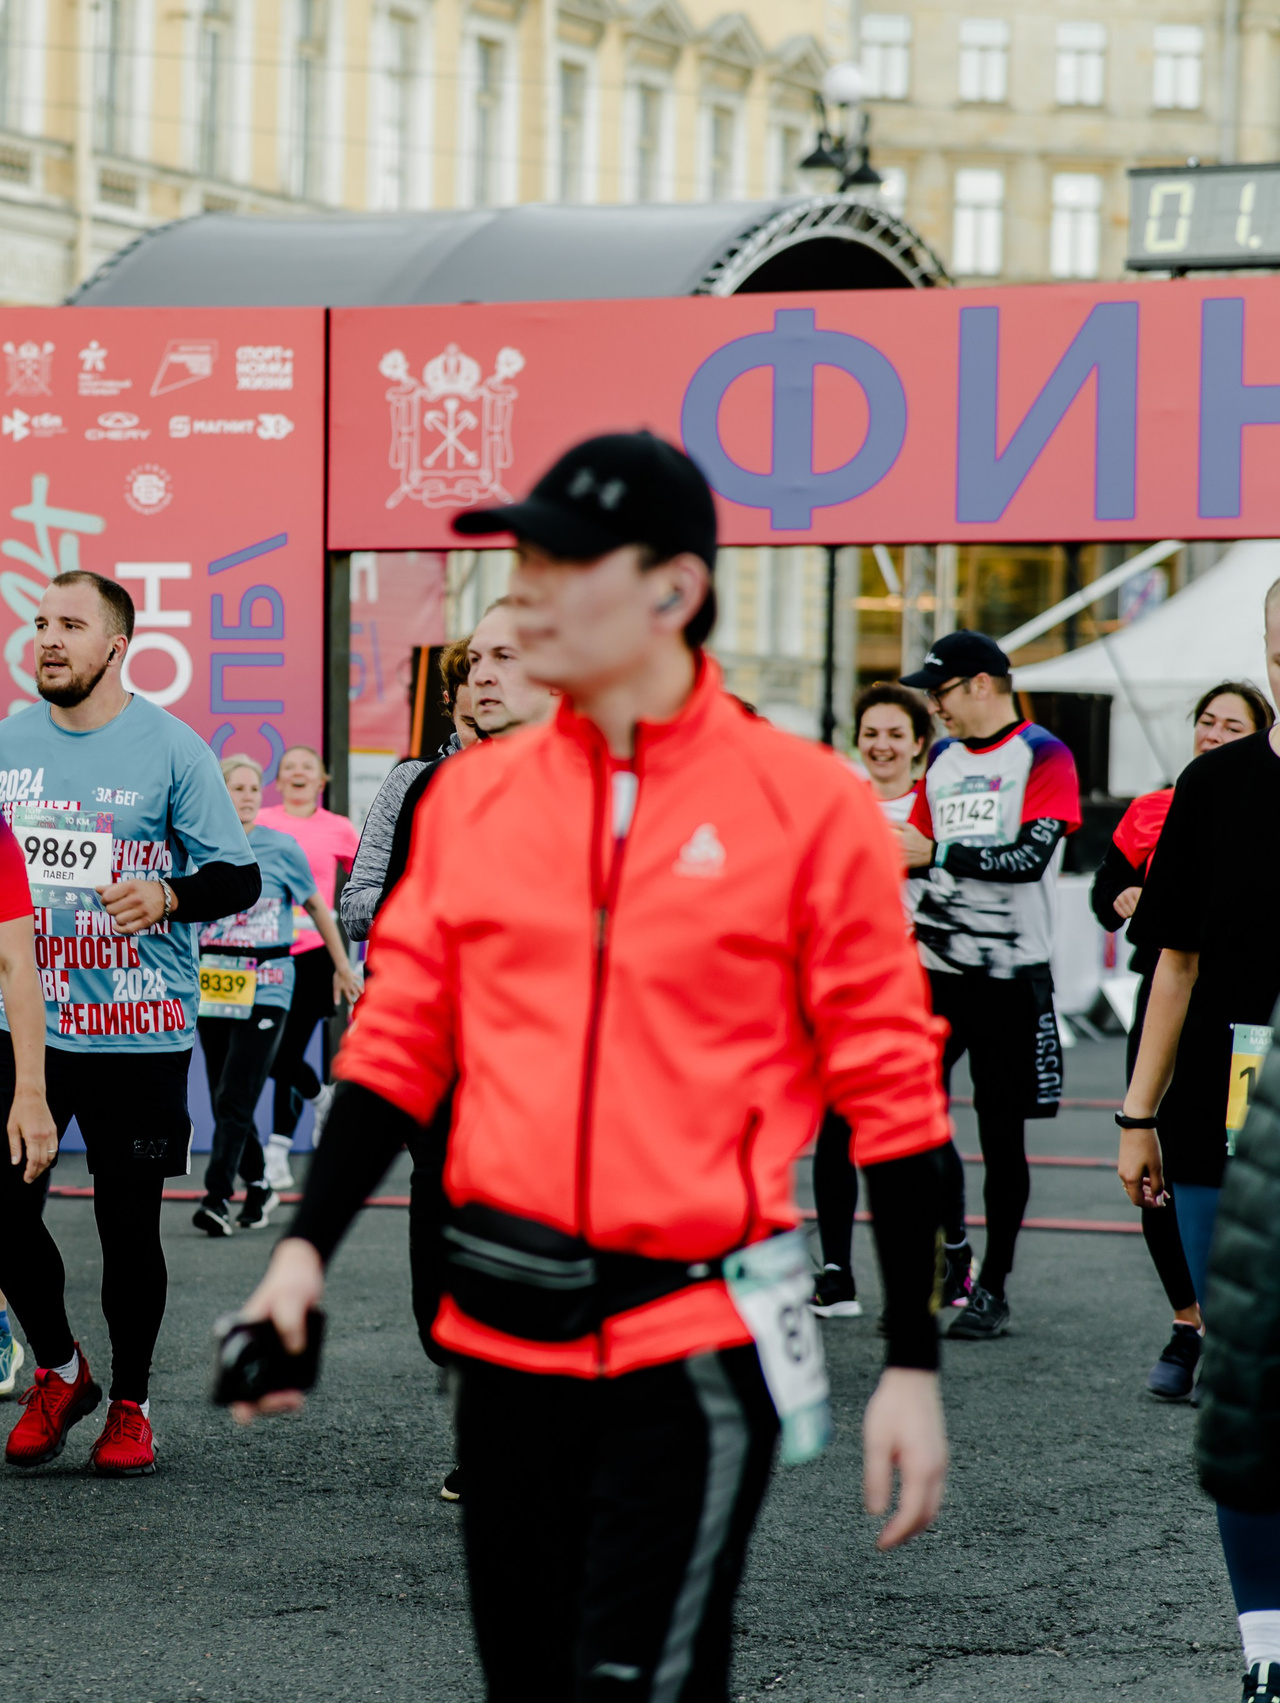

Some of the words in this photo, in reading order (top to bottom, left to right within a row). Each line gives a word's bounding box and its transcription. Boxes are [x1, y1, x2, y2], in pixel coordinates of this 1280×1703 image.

[96, 787, 112, 803] ЗА
[114, 790, 140, 806] БЕГ
[938, 799, 995, 827] 12142
[24, 836, 97, 870] 9869
[42, 869, 75, 881] ПАВЕЛ
[59, 998, 186, 1035] #ЕДИНСТВО
